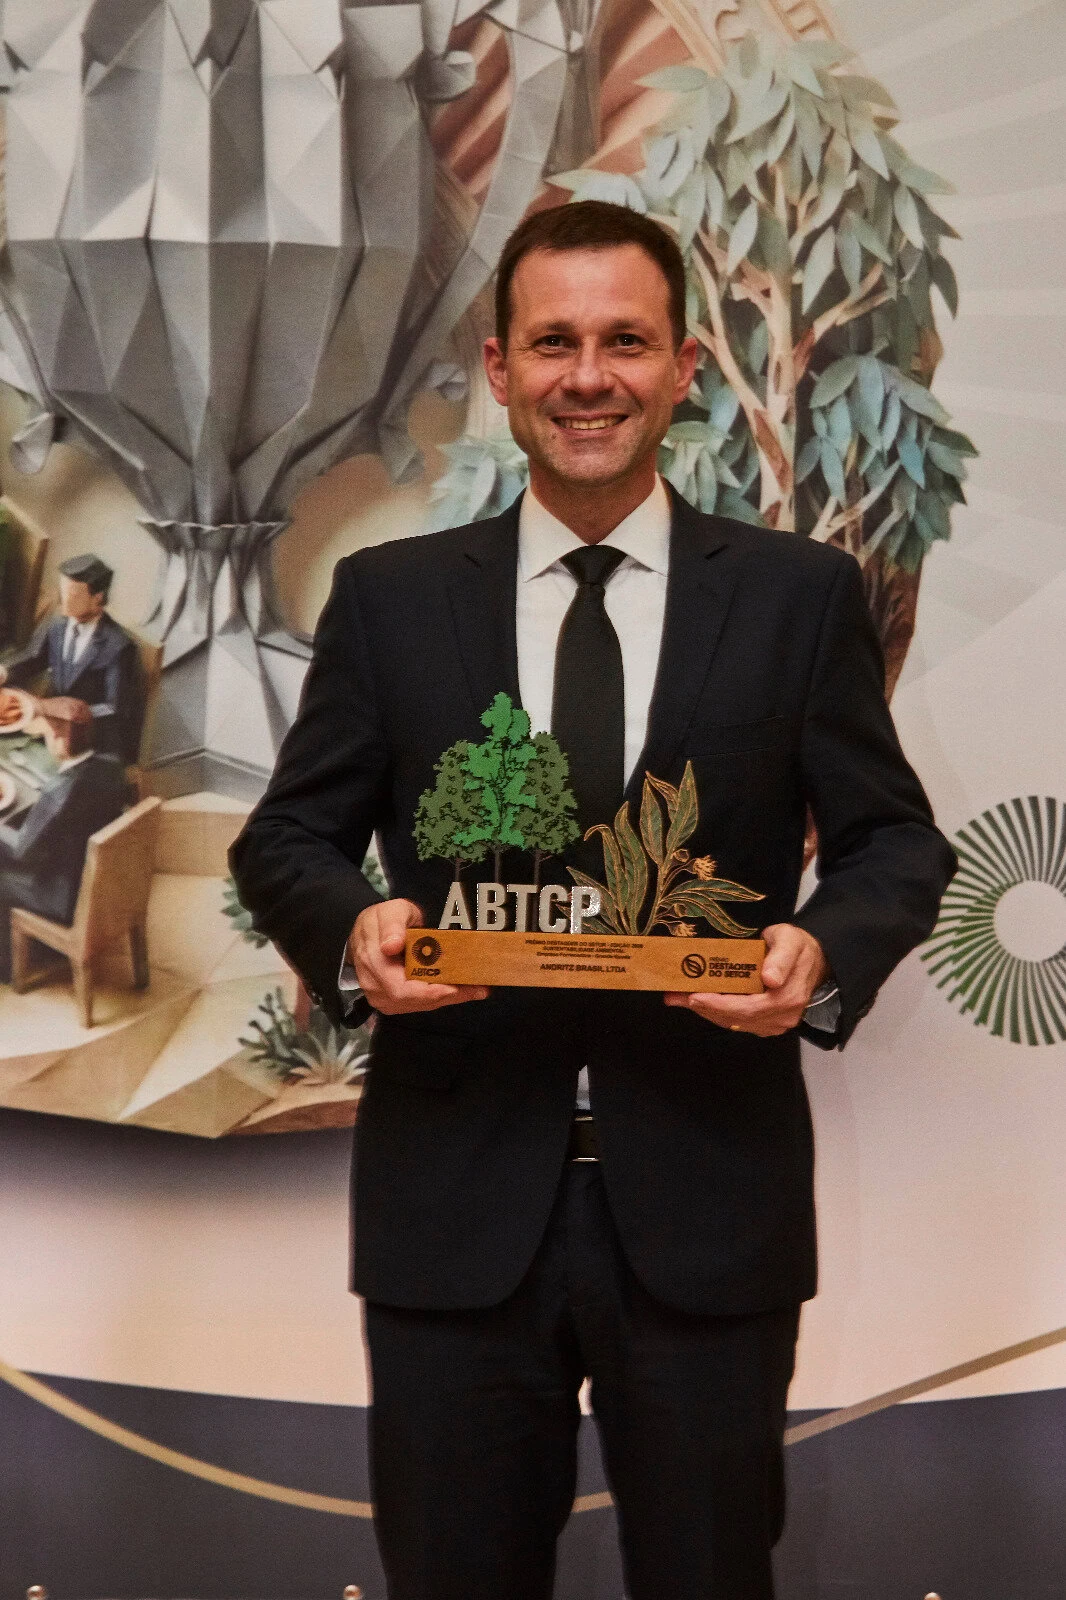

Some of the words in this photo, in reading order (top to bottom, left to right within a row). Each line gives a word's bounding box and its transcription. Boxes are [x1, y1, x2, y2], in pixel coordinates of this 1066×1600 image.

[438, 881, 601, 935] ABTCP
[540, 963, 574, 971] ANDRITZ
[411, 967, 441, 977] ABTCP
[724, 970, 751, 978] SETOR
